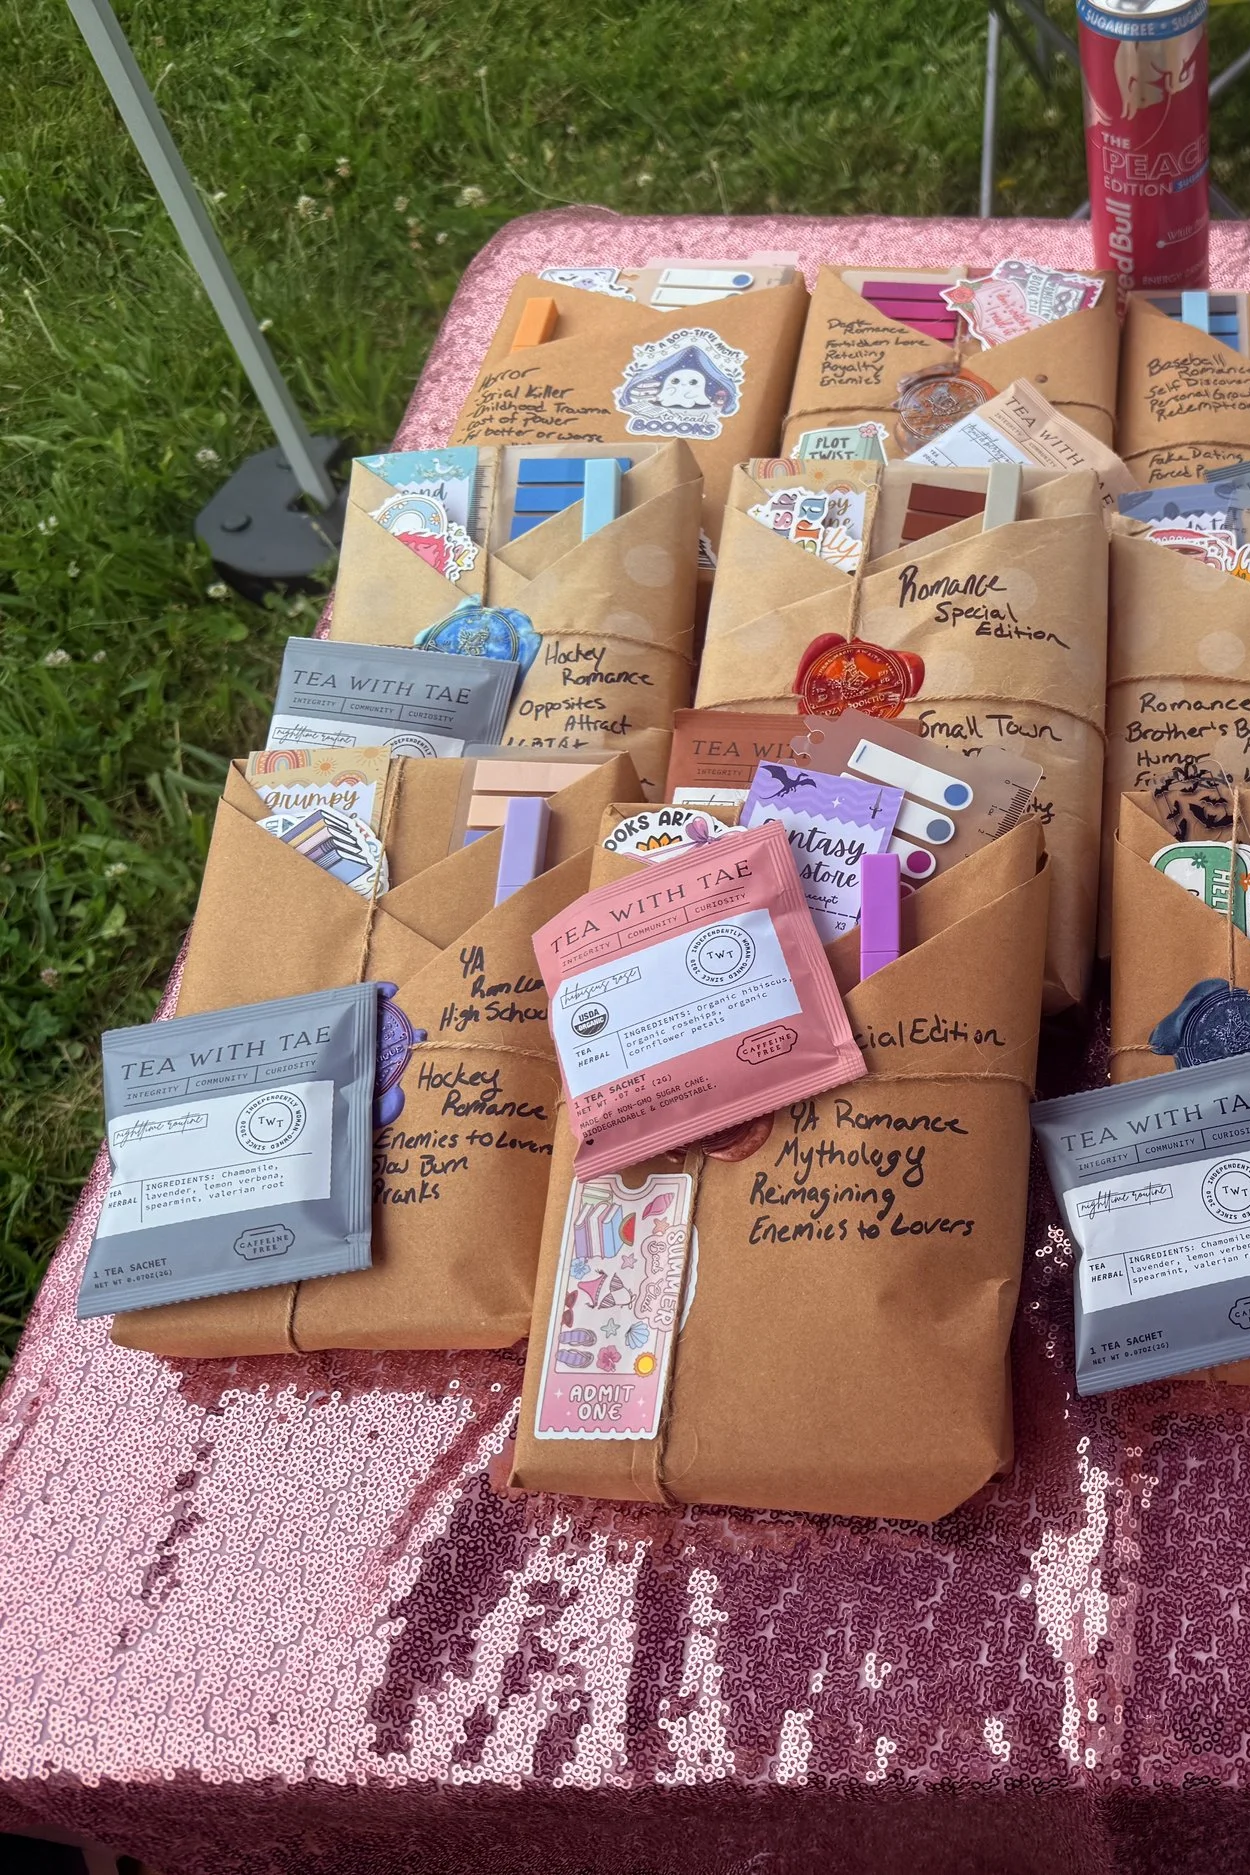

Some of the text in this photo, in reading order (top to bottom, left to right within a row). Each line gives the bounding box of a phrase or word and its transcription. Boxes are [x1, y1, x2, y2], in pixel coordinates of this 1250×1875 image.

[1084, 8, 1155, 36] SUGARFREE
[1101, 132, 1130, 149] THE
[1103, 135, 1208, 180] PEAC
[1104, 176, 1173, 197] EDITION
[1106, 198, 1132, 247] Bull
[821, 362, 884, 377] Royalty
[1147, 353, 1226, 378] Baseball
[819, 374, 882, 387] Enemies
[632, 419, 716, 436] BOOOKS
[1005, 396, 1036, 428] TEA
[1039, 430, 1085, 466] WITH
[815, 437, 850, 449] PLOT
[1149, 450, 1244, 468] Fake Dating
[1149, 465, 1190, 483] Forced
[899, 564, 1008, 608] Romance
[935, 601, 1019, 624] Special
[974, 622, 1071, 650] Edition
[545, 645, 607, 667] Hockey
[293, 669, 472, 705] TEA WITH TAE
[562, 669, 654, 687] Romance
[292, 697, 454, 723] INTEGRITY COMMUNITY CURIOSITY
[519, 695, 607, 720] Opposites
[564, 714, 633, 735] Attract
[918, 709, 1063, 743] Small Town
[1125, 721, 1228, 743] Brother's
[692, 740, 740, 757] TEA
[1137, 750, 1211, 767] Humor
[265, 791, 360, 810] grumpy
[604, 815, 649, 851] OOKS
[550, 859, 753, 955] TEA WITH TAE
[627, 893, 747, 939] COMMUNITY CURIOSITY
[460, 945, 485, 979] YA
[440, 1002, 480, 1032] High
[578, 1008, 601, 1021] USDA
[624, 1009, 692, 1040] INGREDIENTS:
[626, 1029, 666, 1048] organic
[909, 1015, 1006, 1048] Edition
[121, 1025, 332, 1081] TEA WITH TAE
[629, 1034, 685, 1058] cornflower
[742, 1033, 793, 1056] CAFFEINE
[578, 1050, 610, 1068] HERBAL
[127, 1059, 317, 1100] INTEGRITY COMMUNITY CURIOSITY
[417, 1061, 503, 1101] Hockey
[609, 1074, 646, 1094] SACHET
[442, 1089, 549, 1121] Romance
[790, 1099, 969, 1135] YA Romance
[1060, 1127, 1118, 1152] TEA
[1126, 1104, 1203, 1135] WITH
[373, 1127, 553, 1156] Enemies to Lovers
[372, 1154, 469, 1177] Slow Burn
[775, 1137, 927, 1187] Mythology
[1078, 1153, 1129, 1172] INTEGRITY
[1145, 1138, 1196, 1155] COMMUNITY
[145, 1163, 279, 1191] INGREDIENTS: Chamomile,
[145, 1186, 197, 1201] lavender,
[373, 1179, 441, 1205] Pranks
[750, 1171, 896, 1221] Reimagining
[749, 1213, 975, 1245] Enemies to Lovers
[239, 1234, 290, 1250] CAFFEINE
[129, 1257, 168, 1272] SACHET
[1089, 1261, 1106, 1272] TEA
[1128, 1244, 1196, 1265] INGREDIENTS:
[1130, 1257, 1181, 1274] lavender,
[655, 1230, 686, 1326] SUMMER
[1091, 1269, 1125, 1283] HERBAL
[1132, 1254, 1240, 1285] spearmint, valerian
[1101, 1330, 1164, 1352] TEA SACHET
[568, 1384, 635, 1402] ADMIT
[577, 1403, 622, 1421] ONE
